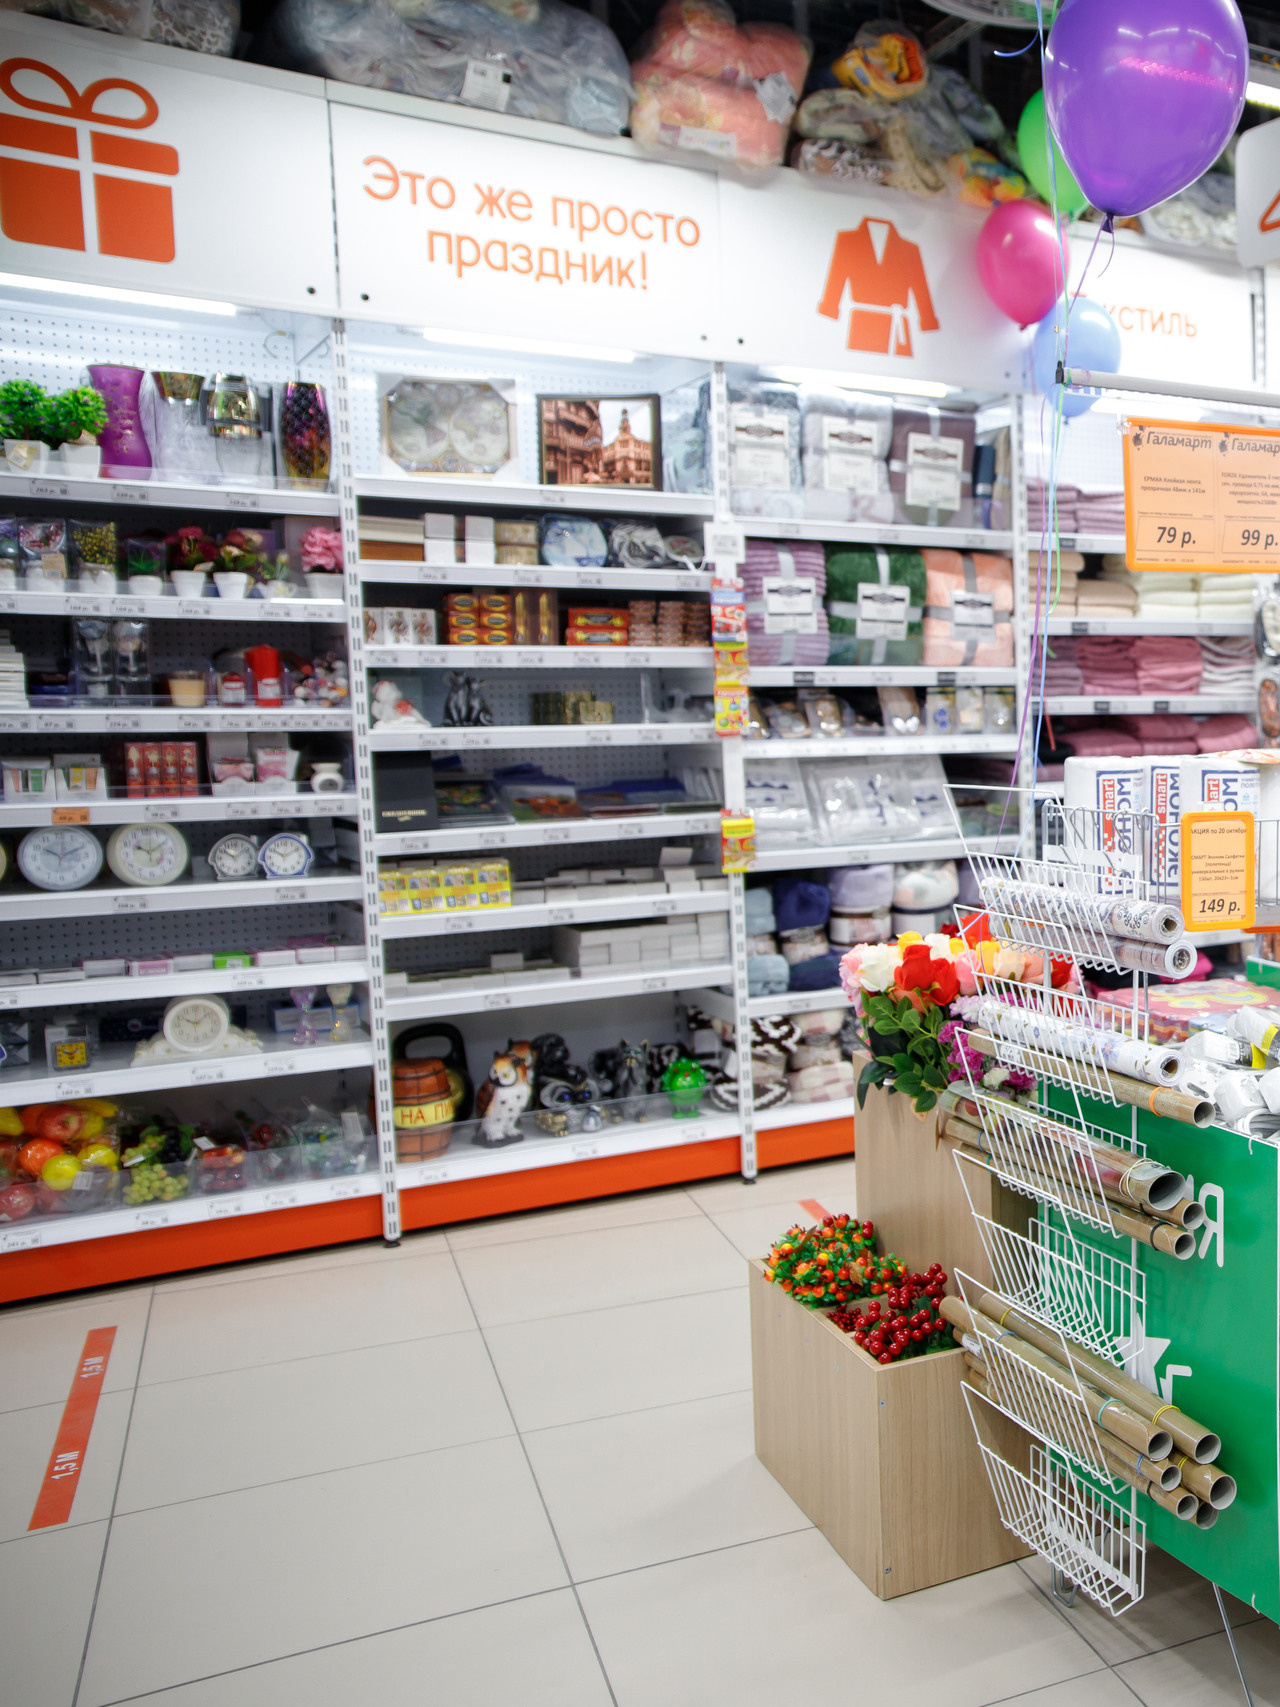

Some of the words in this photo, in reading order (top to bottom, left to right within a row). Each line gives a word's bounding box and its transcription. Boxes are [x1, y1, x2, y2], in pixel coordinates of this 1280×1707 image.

[363, 156, 456, 210] Это
[474, 183, 533, 221] же
[552, 196, 701, 247] просто
[428, 230, 648, 291] праздник!
[1146, 431, 1212, 451] Галамарт
[1157, 526, 1177, 544] 79
[1181, 532, 1196, 548] р.
[1240, 529, 1261, 546] 99
[1264, 534, 1279, 550] р.
[1157, 774, 1168, 814] smart
[1200, 898, 1225, 913] 149
[1228, 901, 1240, 915] р.
[401, 1108, 426, 1125] НА
